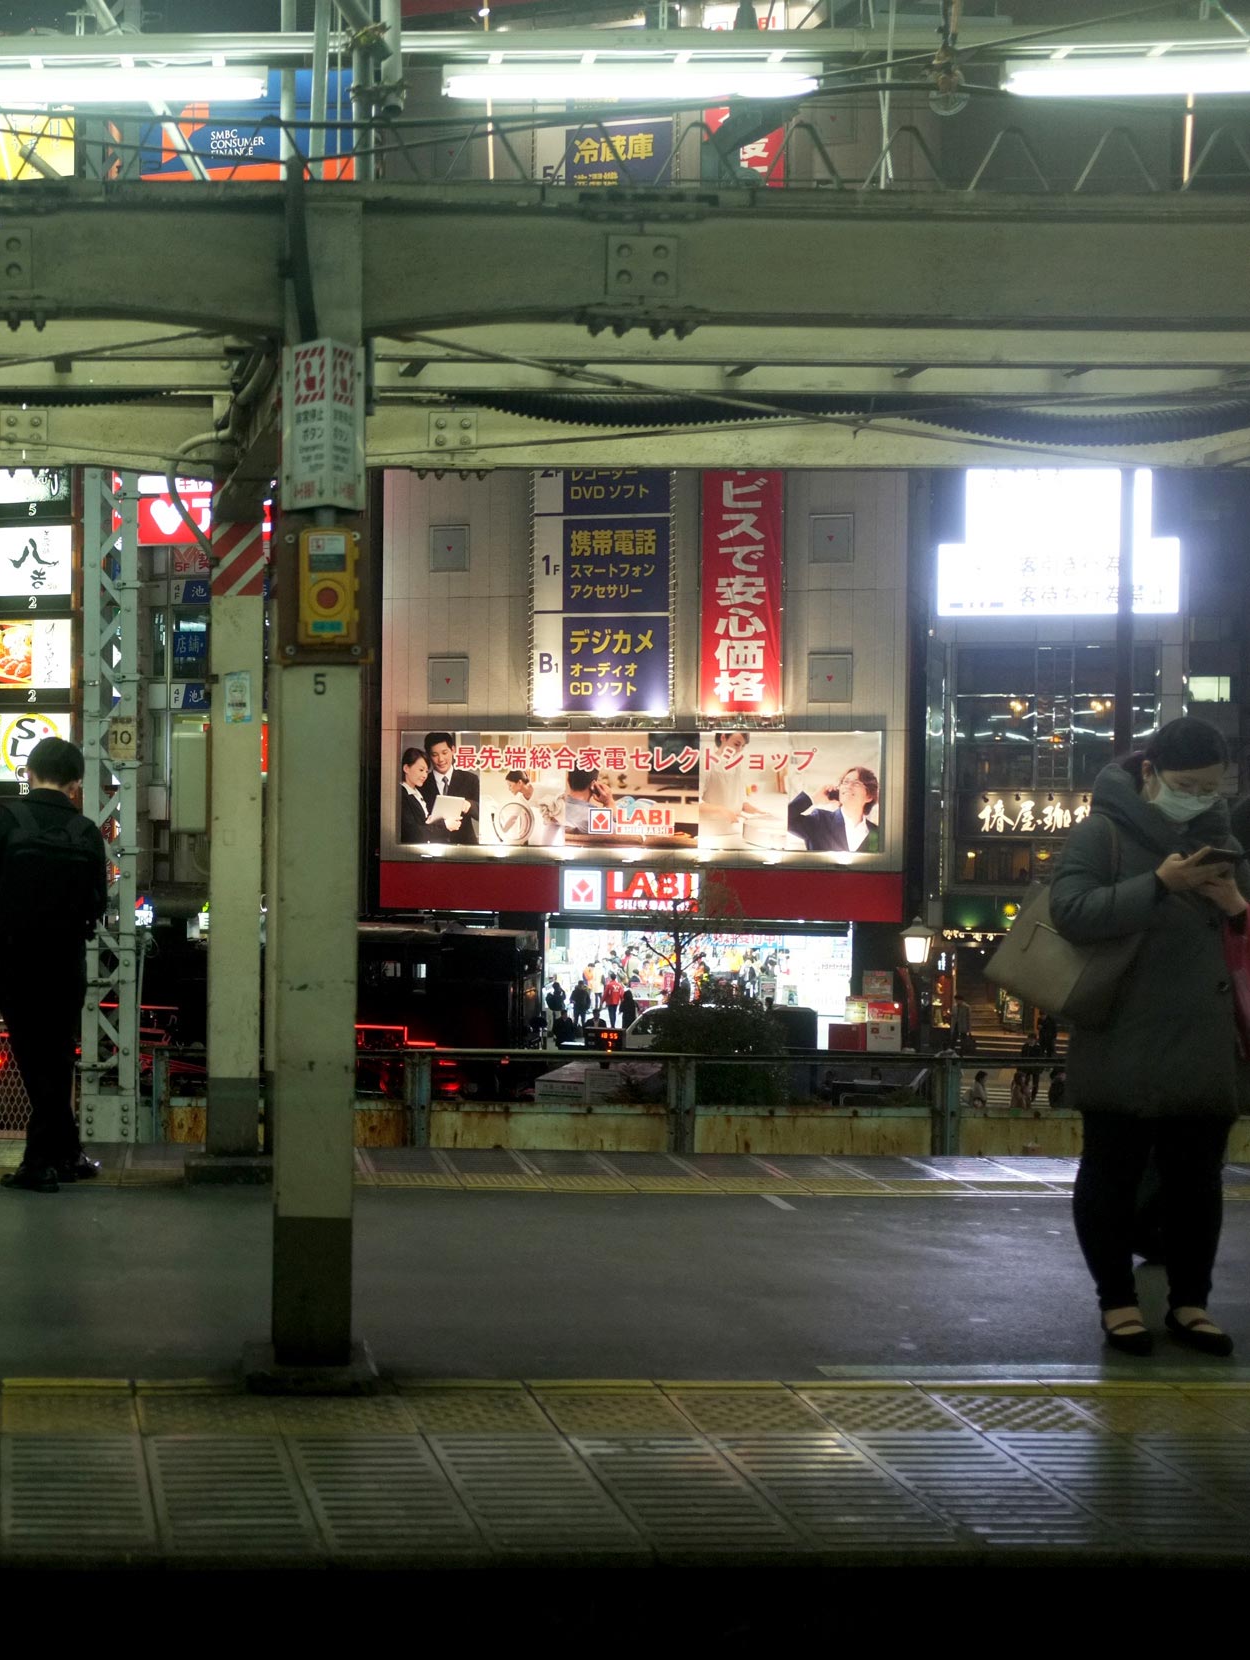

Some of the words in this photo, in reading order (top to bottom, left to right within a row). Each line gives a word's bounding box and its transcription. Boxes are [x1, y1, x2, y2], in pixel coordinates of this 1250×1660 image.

[211, 129, 237, 140] SMBC
[211, 136, 265, 149] CONSUMER
[573, 133, 654, 164] 冷蔵庫
[570, 485, 605, 500] DVD
[610, 484, 650, 499] ソフト
[28, 503, 37, 516] 5
[570, 529, 657, 557] 携帯電話
[174, 562, 190, 573] 5F
[541, 555, 560, 576] 1F
[570, 564, 655, 578] スマートフォン
[174, 584, 181, 601] 4F
[191, 586, 207, 598] 池
[570, 584, 643, 598] アクセサリー
[714, 472, 767, 702] ビスで安心価格
[28, 596, 37, 609] 2
[570, 629, 654, 655] デジカメ
[539, 652, 559, 674] B1
[570, 663, 638, 677] オーディオ
[313, 673, 327, 695] 5
[570, 682, 593, 696] CD
[597, 682, 637, 696] ソフト
[27, 690, 37, 702] 2
[173, 688, 180, 704] 4F
[111, 730, 132, 745] 10
[455, 746, 818, 772] 最先端総合家電セレクトショップ
[617, 809, 671, 825] LABI
[606, 870, 696, 899] LABI
